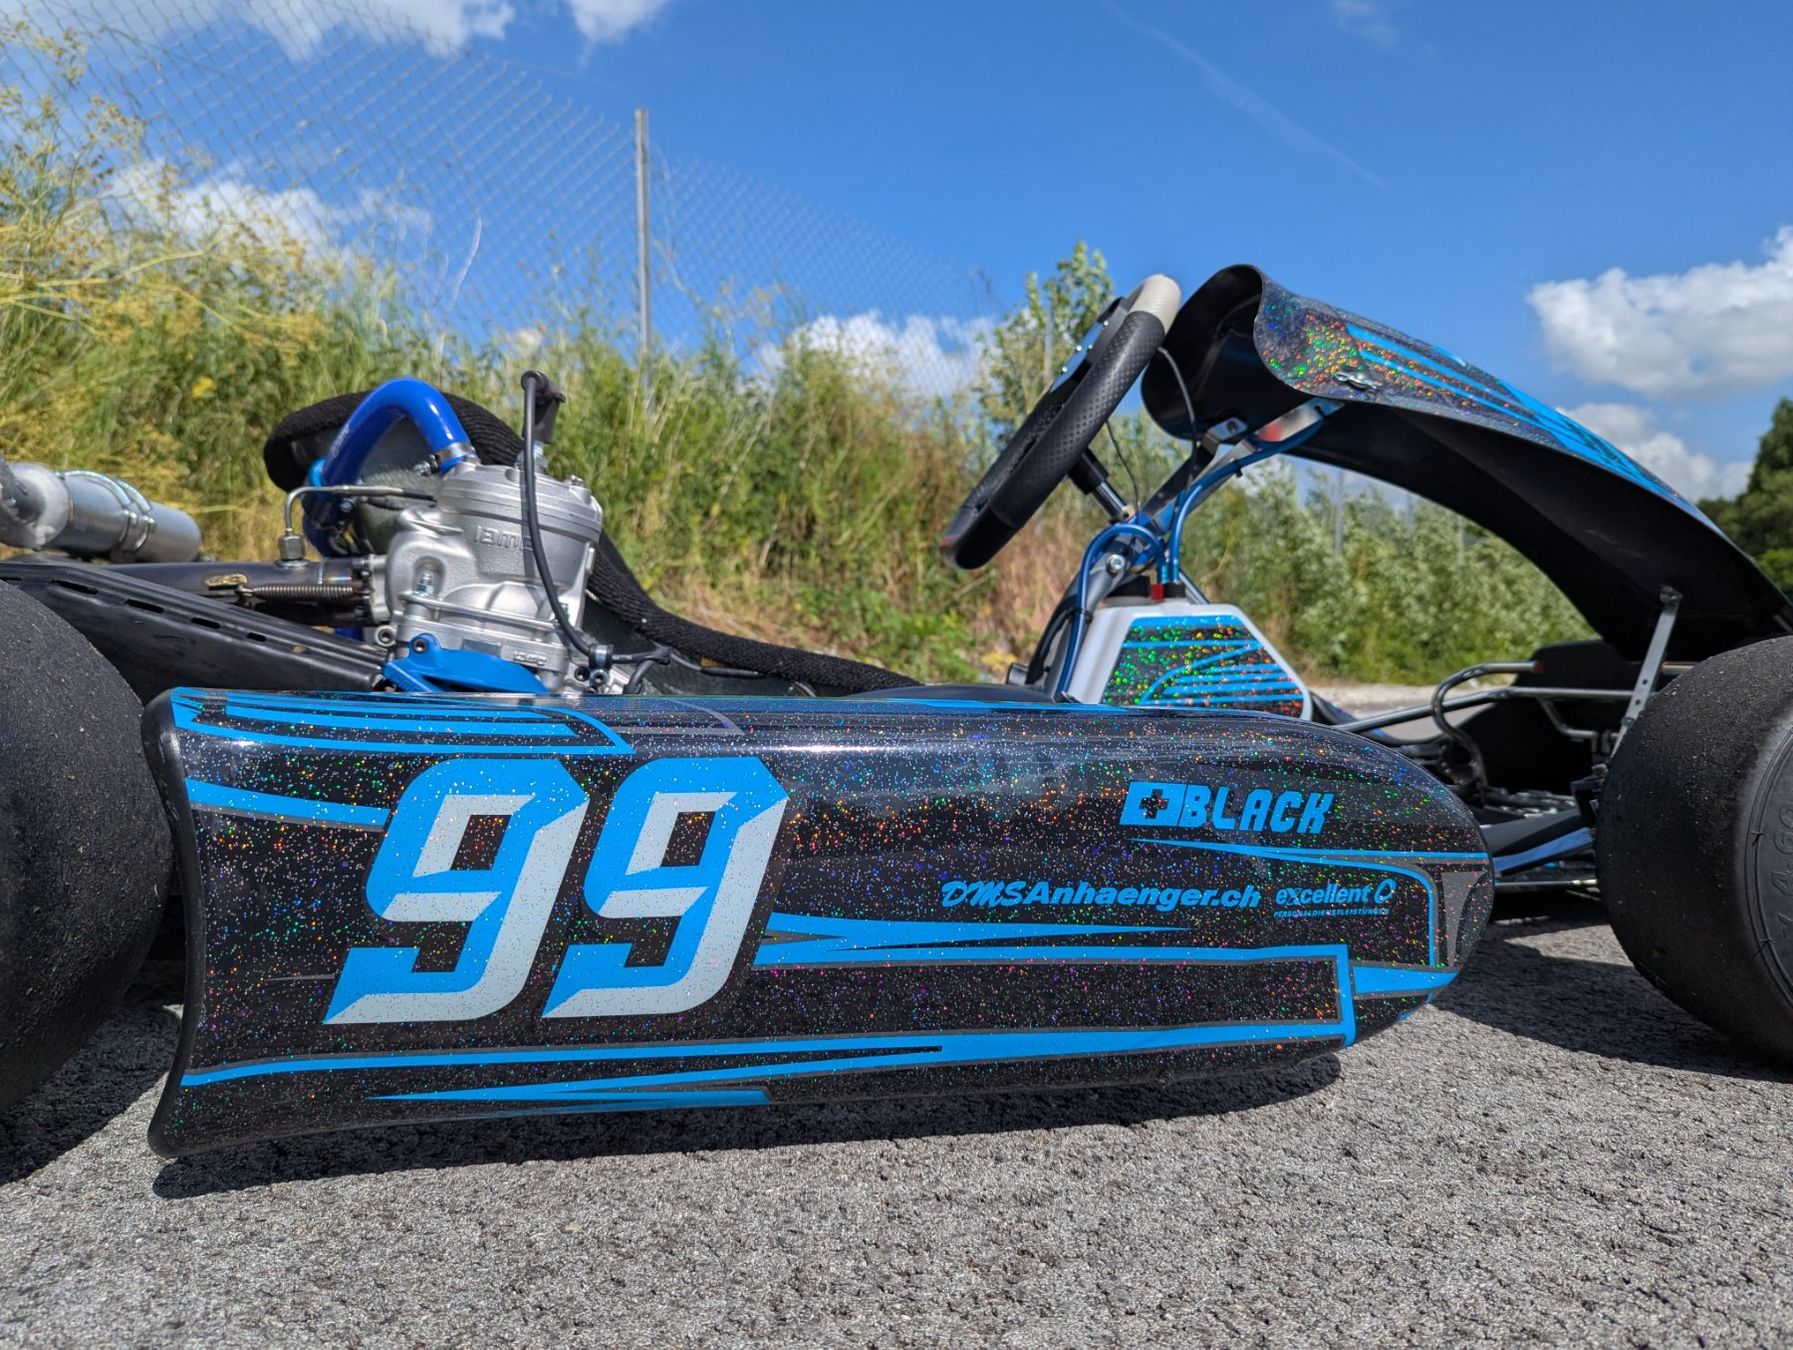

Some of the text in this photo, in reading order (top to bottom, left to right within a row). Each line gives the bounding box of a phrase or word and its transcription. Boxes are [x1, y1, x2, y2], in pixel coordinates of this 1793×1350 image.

[1179, 784, 1334, 834] BLACK
[323, 757, 788, 1025] 99
[941, 879, 1260, 912] DMSAnhaenger.ch
[1275, 882, 1371, 905] excellent
